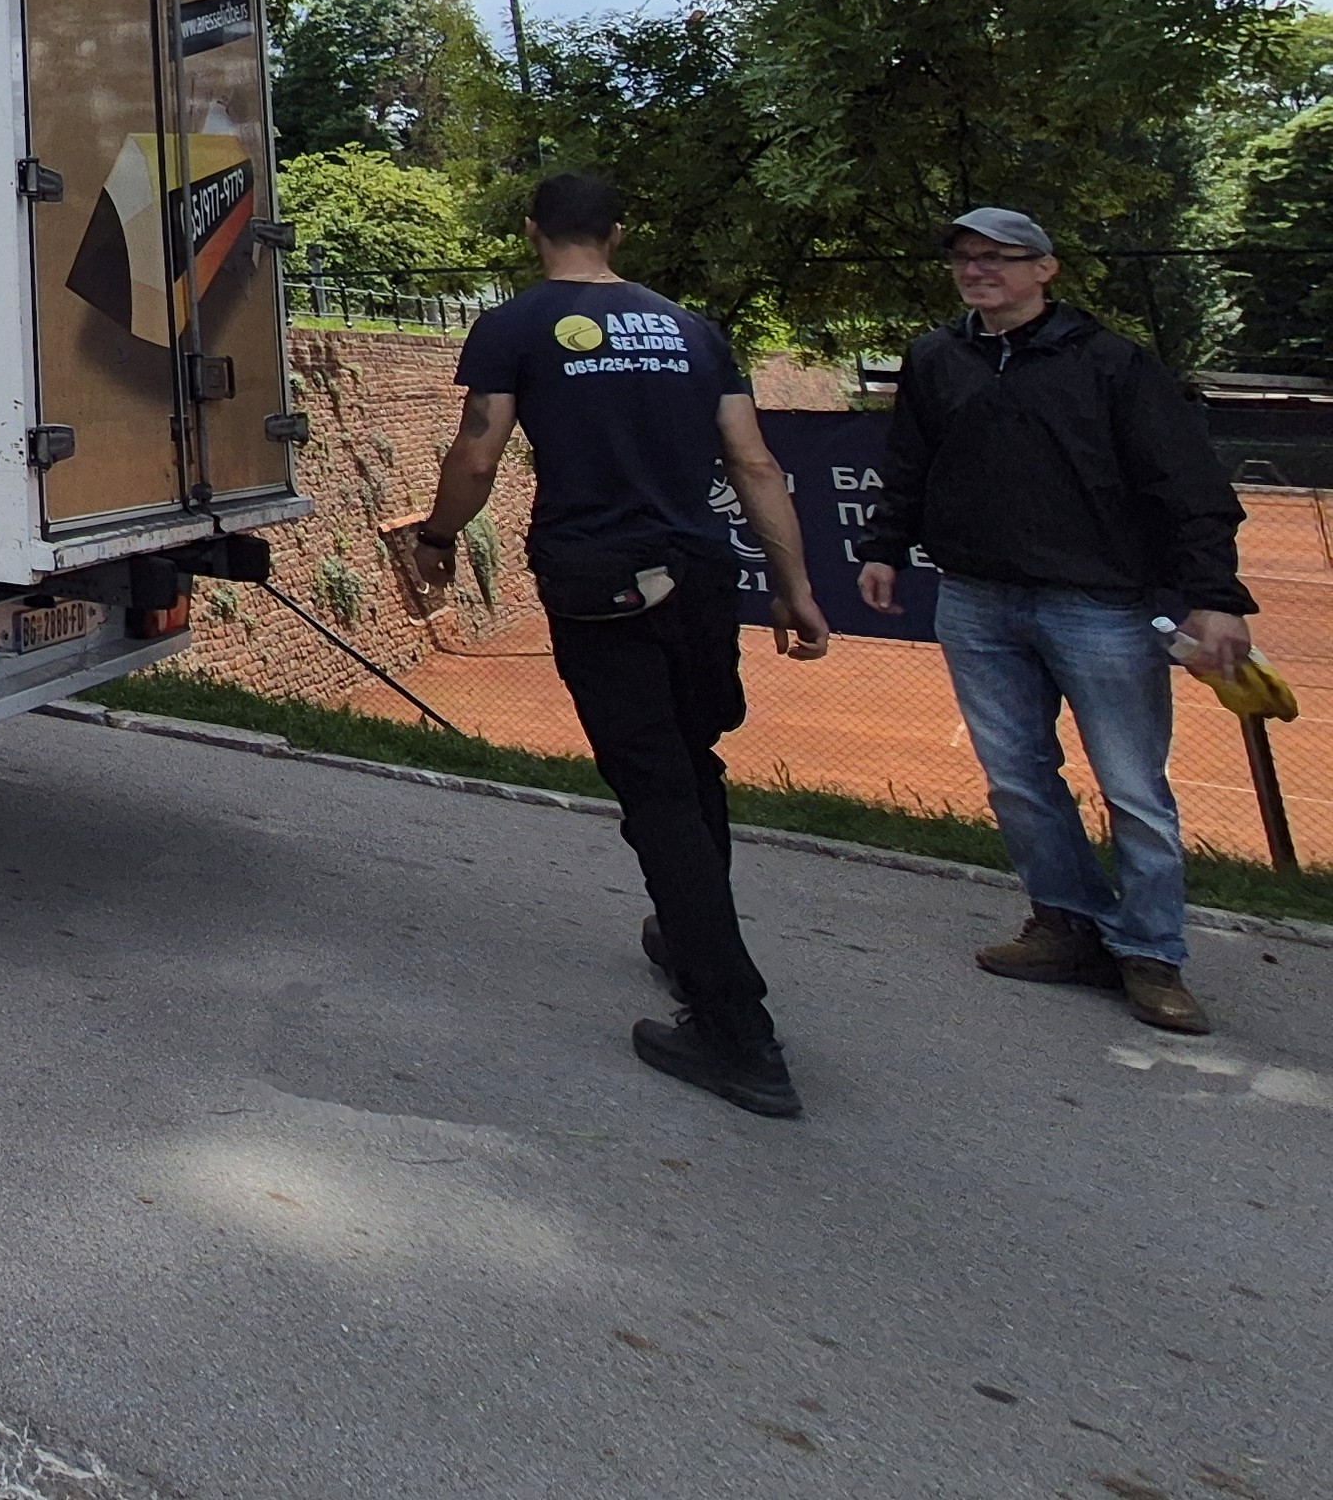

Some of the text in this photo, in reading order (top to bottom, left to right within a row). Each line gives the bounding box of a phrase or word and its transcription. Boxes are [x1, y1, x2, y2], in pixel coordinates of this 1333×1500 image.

[606, 312, 680, 335] ARES
[609, 335, 688, 352] SELIDBE
[563, 357, 690, 376] 065/254-78-49
